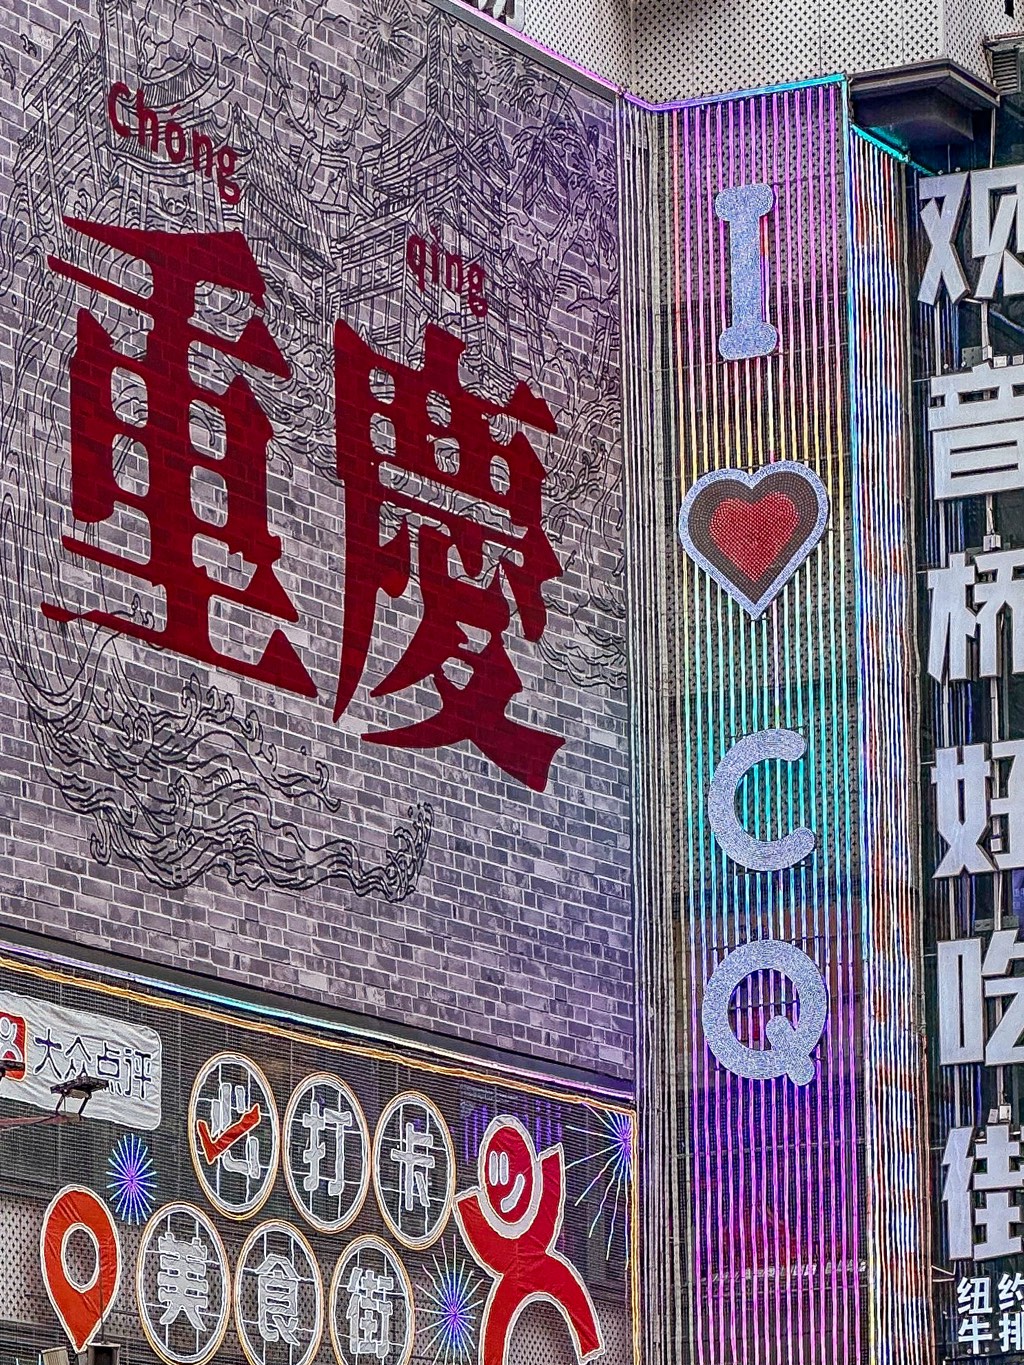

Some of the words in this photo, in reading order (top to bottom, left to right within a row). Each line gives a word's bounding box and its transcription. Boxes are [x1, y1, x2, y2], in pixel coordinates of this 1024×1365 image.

[41, 215, 567, 792] 重慶
[34, 1027, 152, 1102] 大众点评
[197, 1082, 435, 1212] 必打卡
[157, 1231, 394, 1359] 美食街
